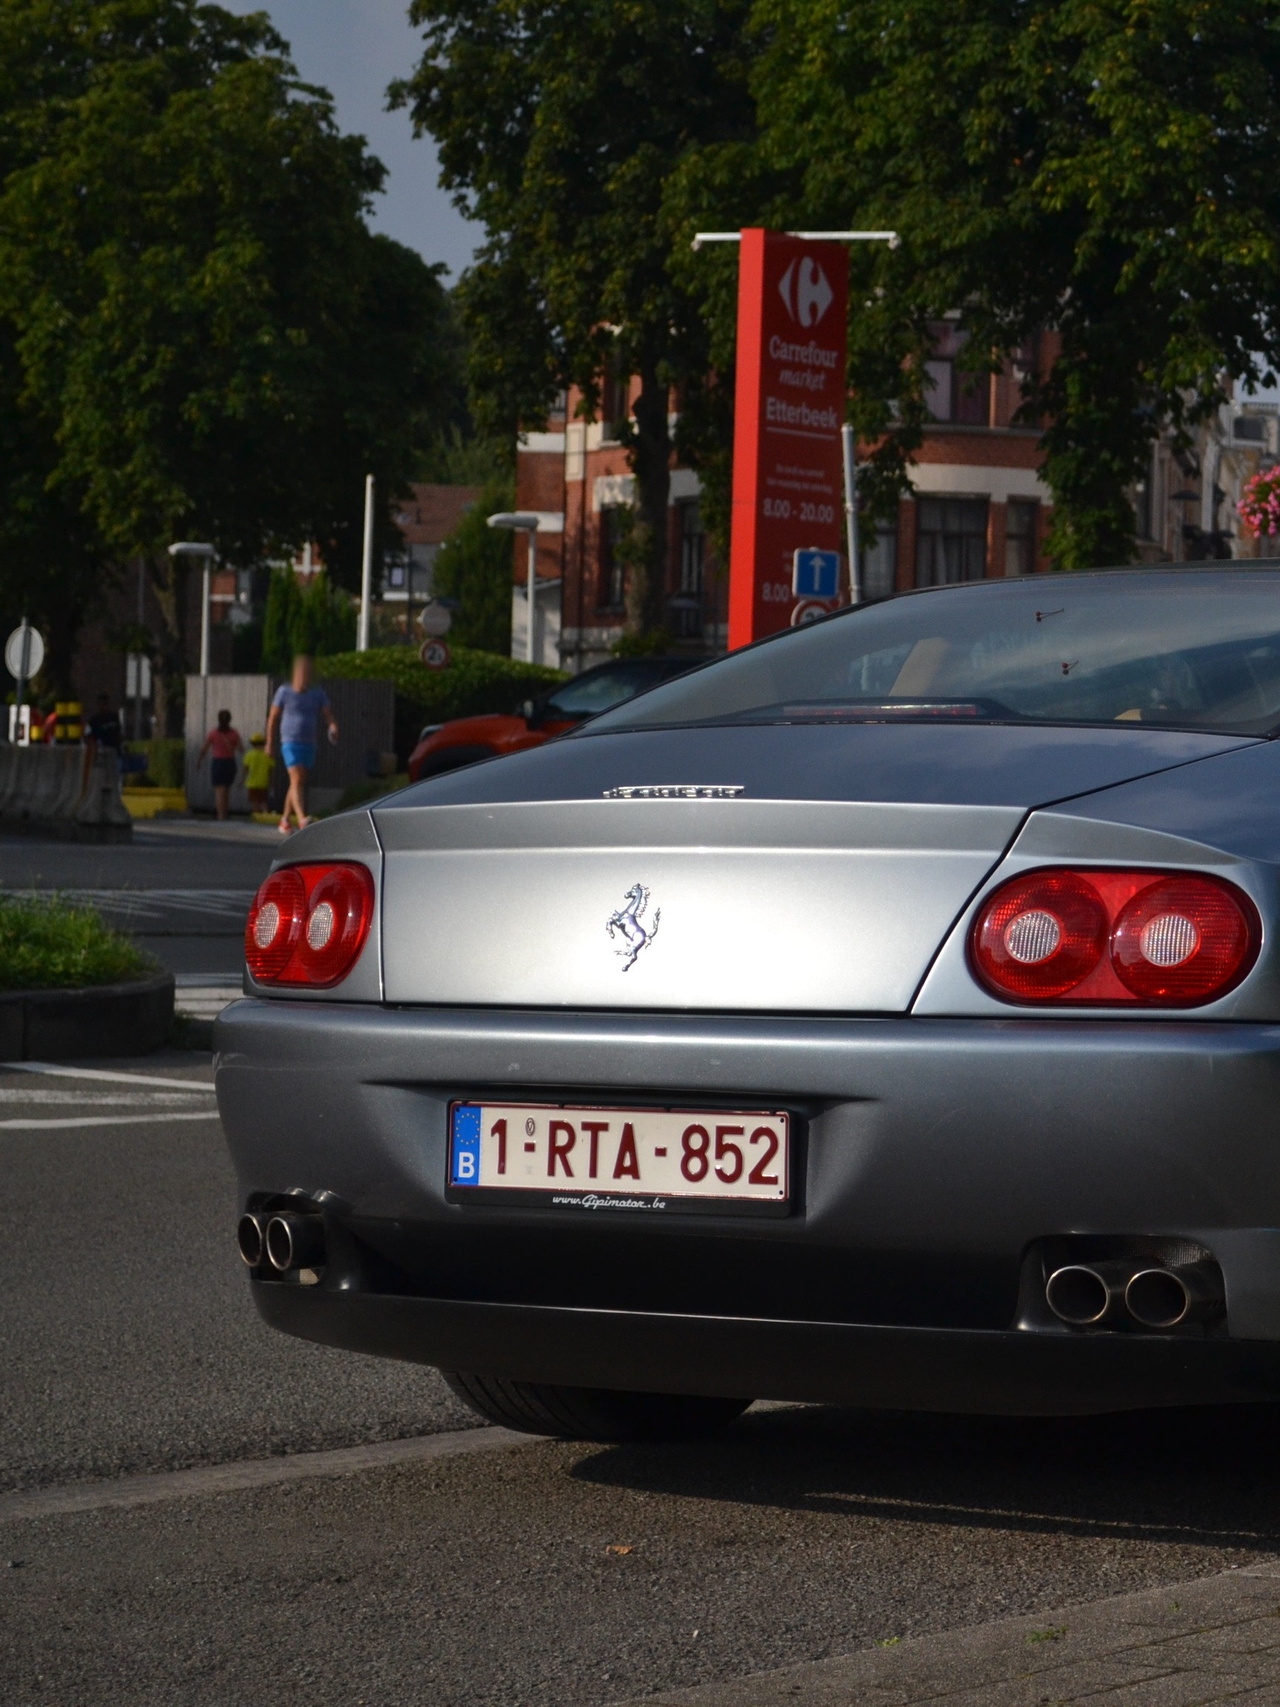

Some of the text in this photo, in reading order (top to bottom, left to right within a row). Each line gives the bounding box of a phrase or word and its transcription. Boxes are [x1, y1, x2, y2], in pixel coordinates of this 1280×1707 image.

[769, 335, 838, 368] Carrefour
[779, 369, 826, 391] market
[766, 396, 837, 428] Etterbeek
[763, 498, 790, 518] 8.00
[800, 501, 834, 523] 20.00
[762, 583, 789, 602] 8.00
[490, 1118, 779, 1185] 1-RTA-852
[457, 1152, 475, 1178] B
